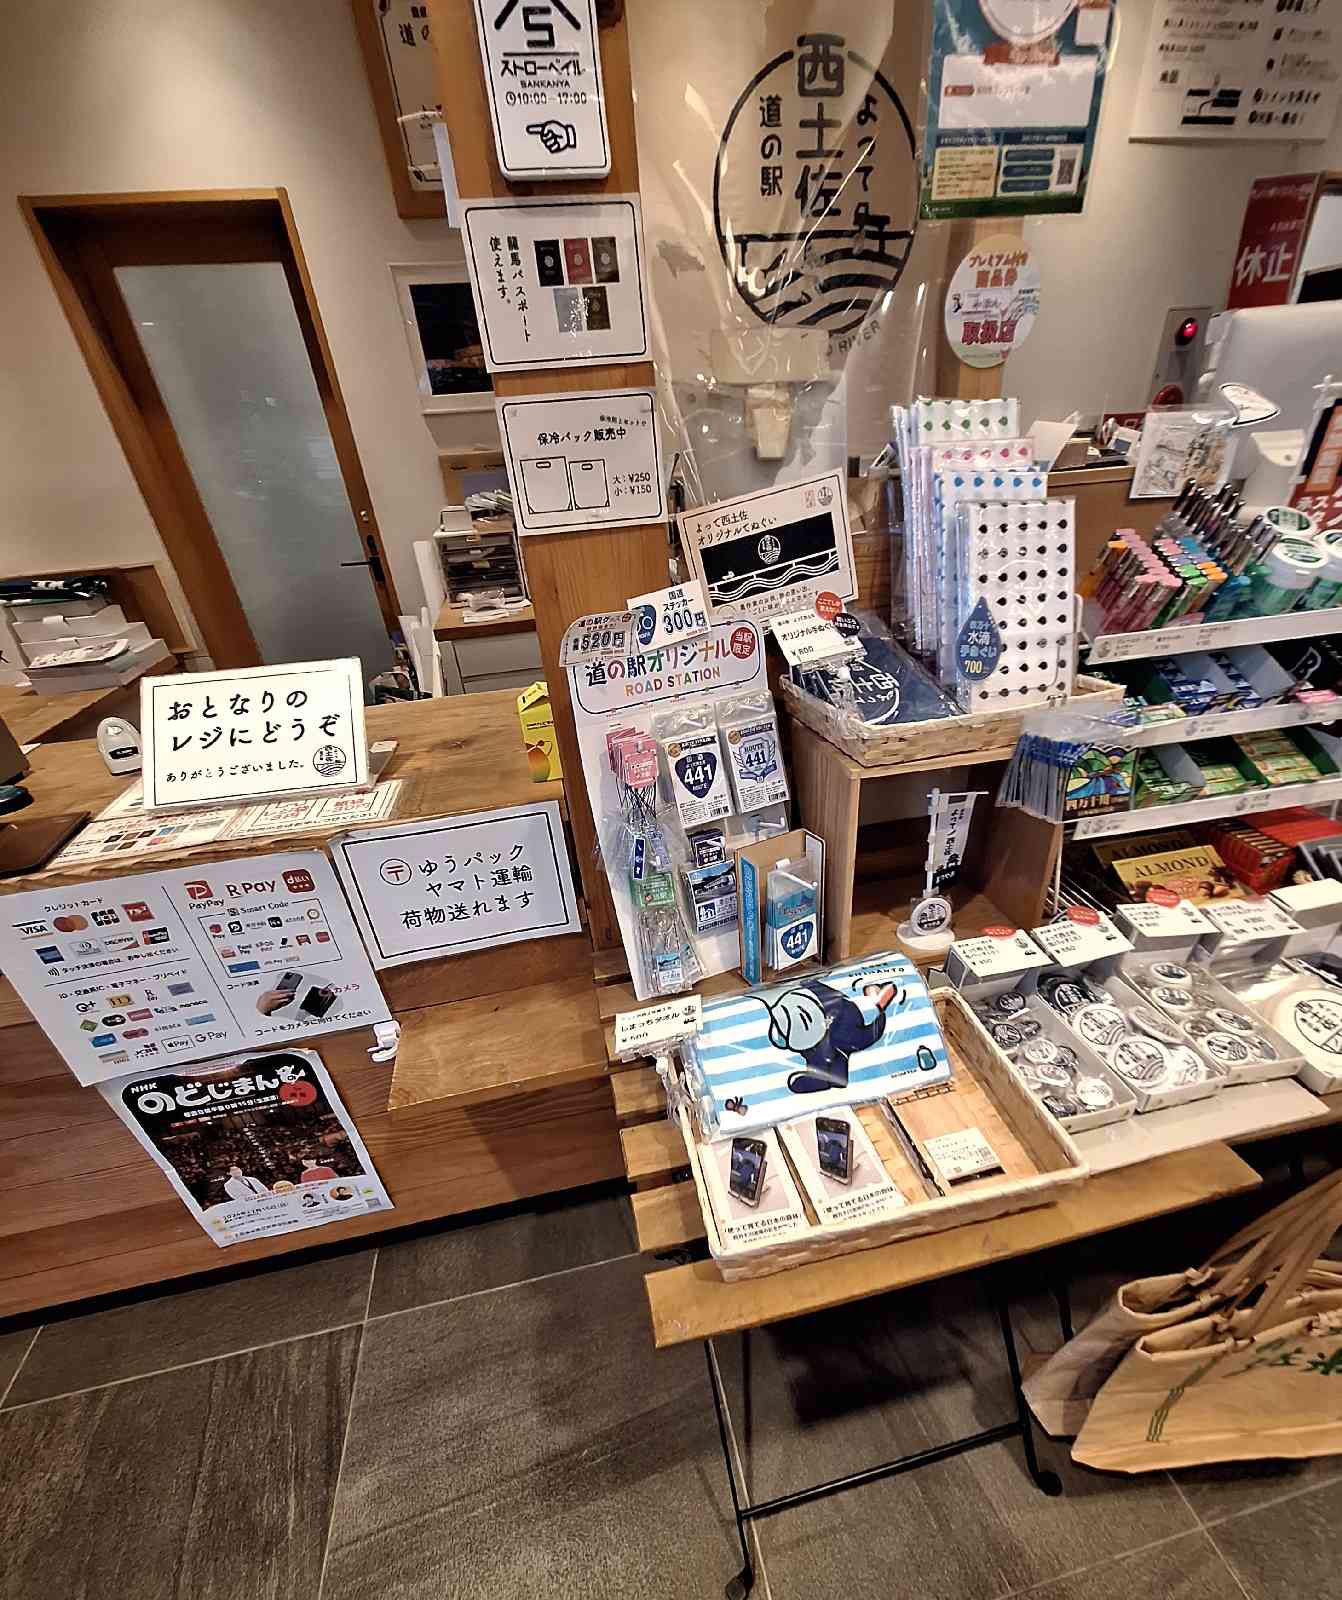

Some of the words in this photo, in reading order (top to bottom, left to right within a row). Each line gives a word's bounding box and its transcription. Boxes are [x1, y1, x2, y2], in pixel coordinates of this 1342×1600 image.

[500, 58, 581, 77] ストローベイル
[796, 34, 845, 217] 西土佐
[760, 97, 783, 197] 道の駅
[857, 95, 878, 191] よって
[489, 236, 511, 303] 使えます。
[1236, 242, 1293, 287] 休止
[537, 427, 627, 445] 保冷パック販売中
[696, 510, 749, 533] よって西土佐
[698, 517, 777, 545] オリジナルてぬぐい
[663, 599, 694, 611] ステッカー
[663, 609, 707, 633] 300円
[735, 631, 753, 643] 当駅
[733, 644, 751, 657] 限定
[585, 638, 730, 687] 道の駅オリジナル
[965, 660, 983, 673] 700
[624, 678, 662, 697] ROAD
[668, 666, 720, 688] STATION
[167, 690, 308, 721] おとなりの
[172, 714, 340, 752] レジにどうぞ
[745, 750, 767, 768] 441
[166, 759, 305, 783] ありがとうございました。
[684, 764, 713, 785] 441
[418, 844, 525, 876] ゆうパック
[1135, 856, 1209, 878] ALMOND
[425, 865, 534, 898] ヤマト運輸
[44, 897, 104, 912] クレジットカード
[189, 899, 225, 910] PayPay
[240, 905, 266, 915] Smart
[268, 900, 289, 910] Code
[400, 890, 535, 929] 荷物送れます
[21, 926, 48, 935] VISA
[786, 929, 808, 950] 441
[334, 983, 361, 994] カメラ
[208, 1031, 228, 1040] Pay
[131, 1082, 158, 1094] NHK
[138, 1074, 280, 1115] のどじまん
